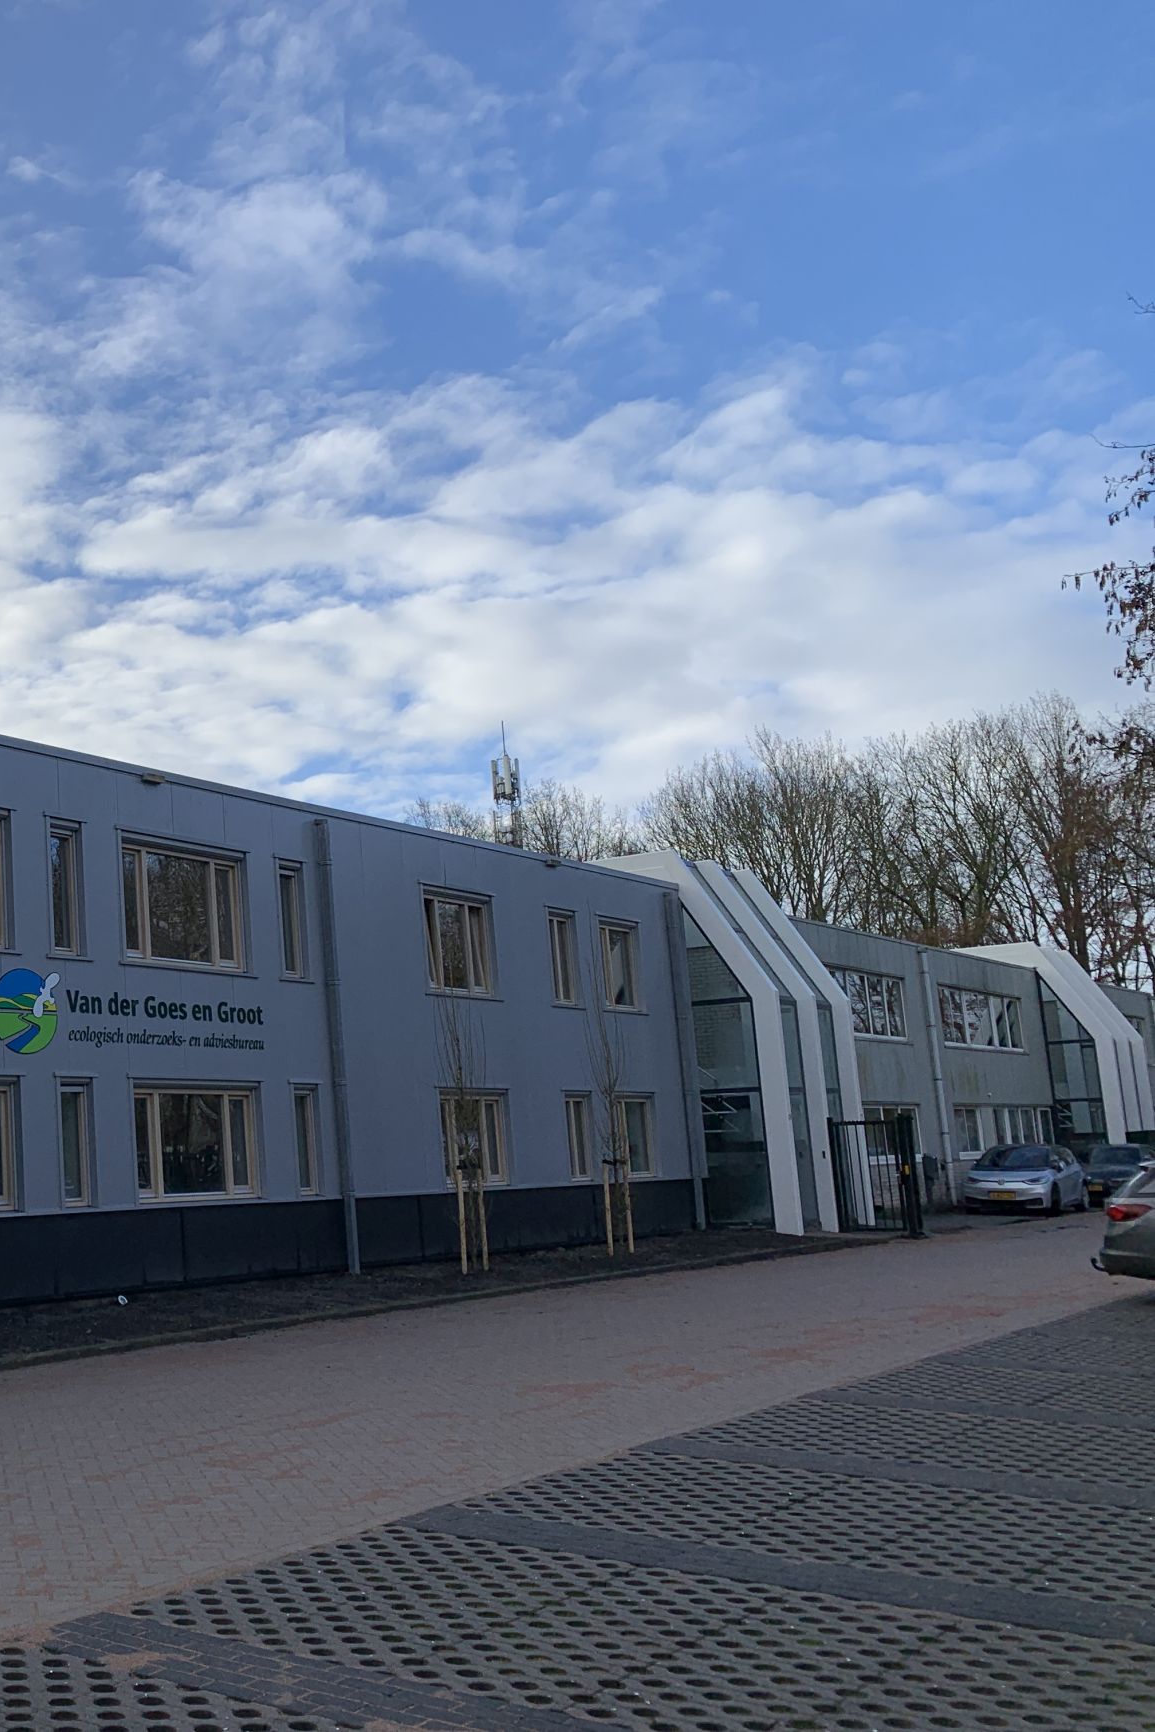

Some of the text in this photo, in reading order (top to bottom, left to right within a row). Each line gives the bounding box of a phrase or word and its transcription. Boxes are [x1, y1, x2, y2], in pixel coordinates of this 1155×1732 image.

[66, 989, 264, 1026] Van der Goes en Groot
[68, 1026, 265, 1051] ecologisch onderzoeks- en adviesbureau
